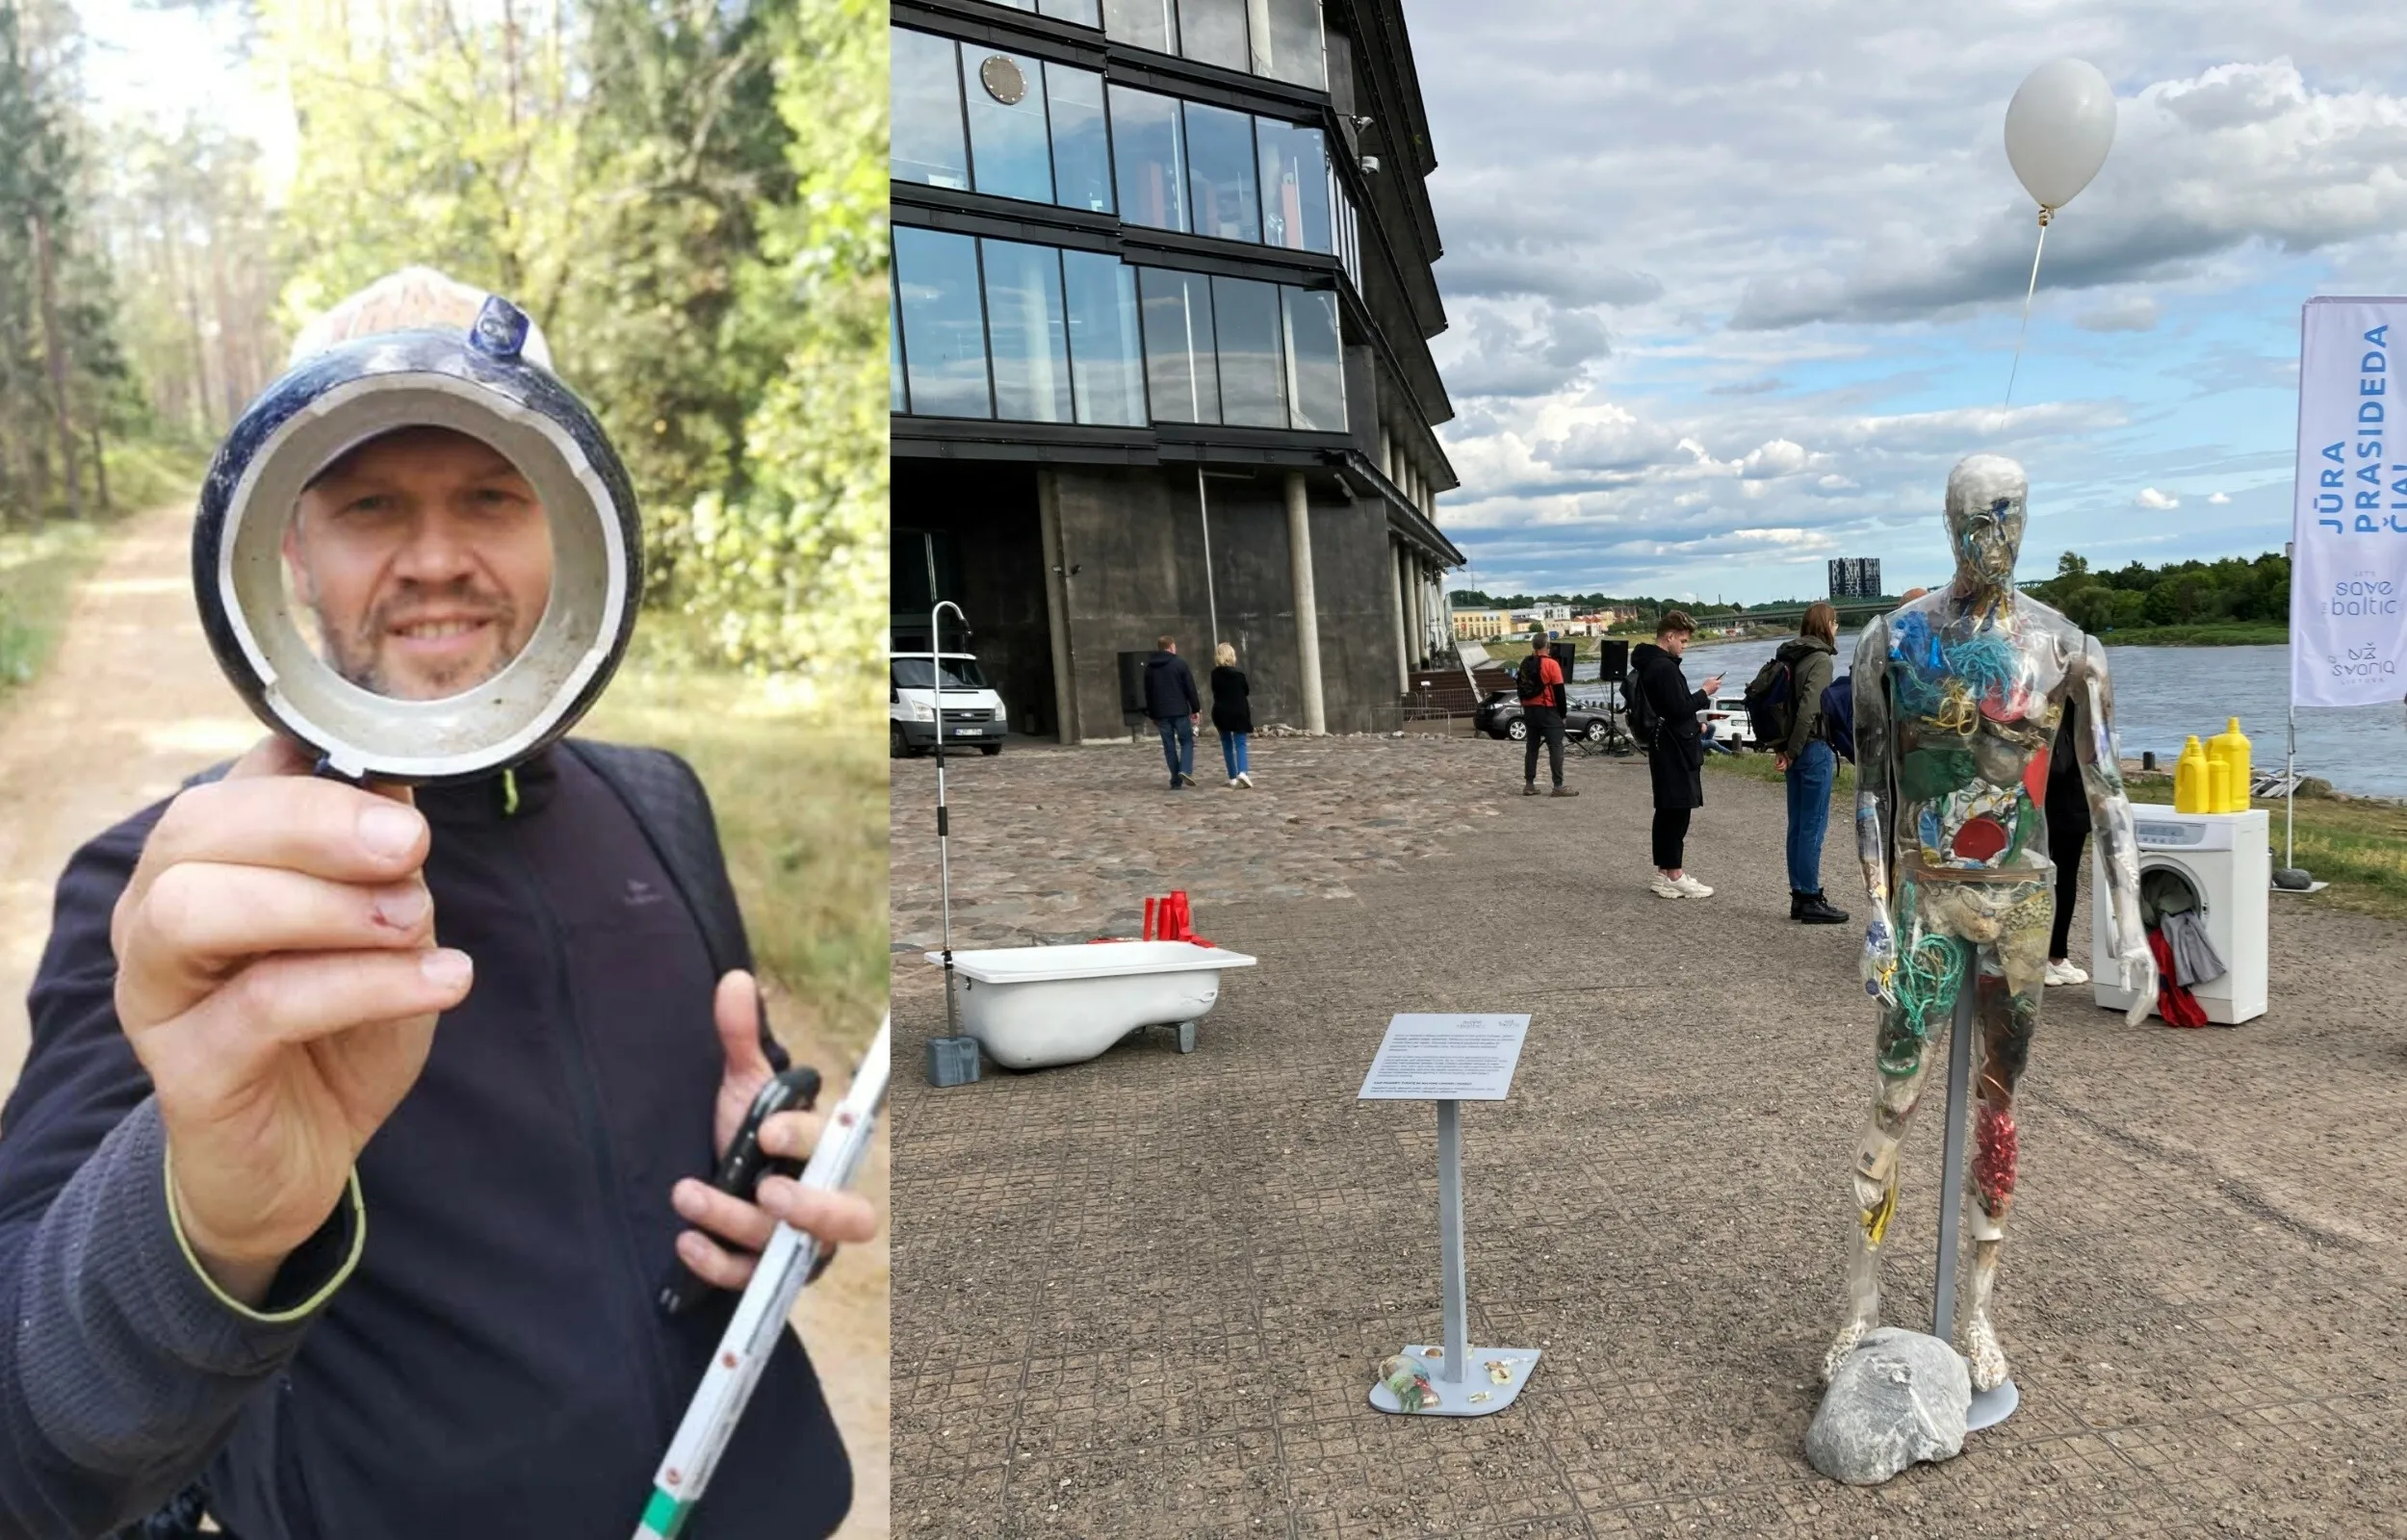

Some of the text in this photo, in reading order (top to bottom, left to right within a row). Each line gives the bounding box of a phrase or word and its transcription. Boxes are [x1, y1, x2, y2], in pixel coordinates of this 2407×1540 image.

[2352, 323, 2390, 535] PRASIDEDA
[2313, 439, 2347, 535] JŪRA
[2331, 596, 2396, 616] baltic
[2335, 580, 2394, 597] save
